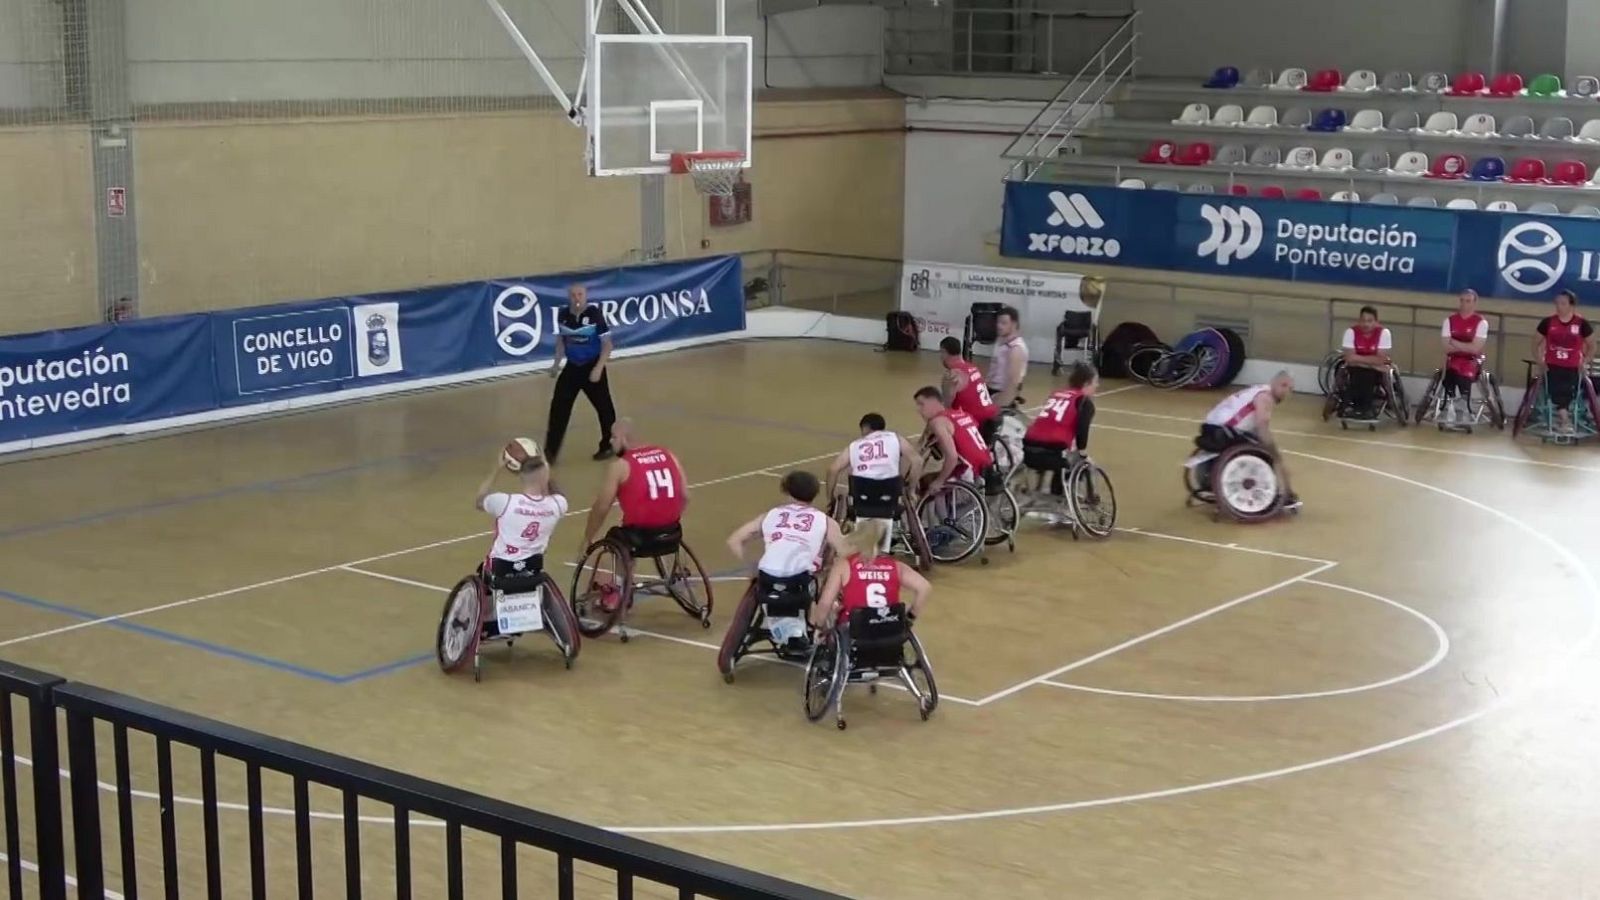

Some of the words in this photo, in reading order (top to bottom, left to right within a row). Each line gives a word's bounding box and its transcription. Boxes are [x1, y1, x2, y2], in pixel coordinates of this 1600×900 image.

[1028, 233, 1120, 258] XFORZO
[1277, 218, 1417, 248] Deputación
[1275, 243, 1415, 274] Pontevedra
[243, 323, 342, 353] CONCELLO
[257, 355, 283, 375] DE
[287, 348, 334, 370] VIGO
[1038, 398, 1070, 422] 24
[858, 441, 888, 462] 31
[645, 467, 675, 501] 14
[521, 521, 539, 542] 4
[775, 511, 815, 533] 13
[857, 571, 890, 582] WEISS
[866, 583, 888, 609] 6
